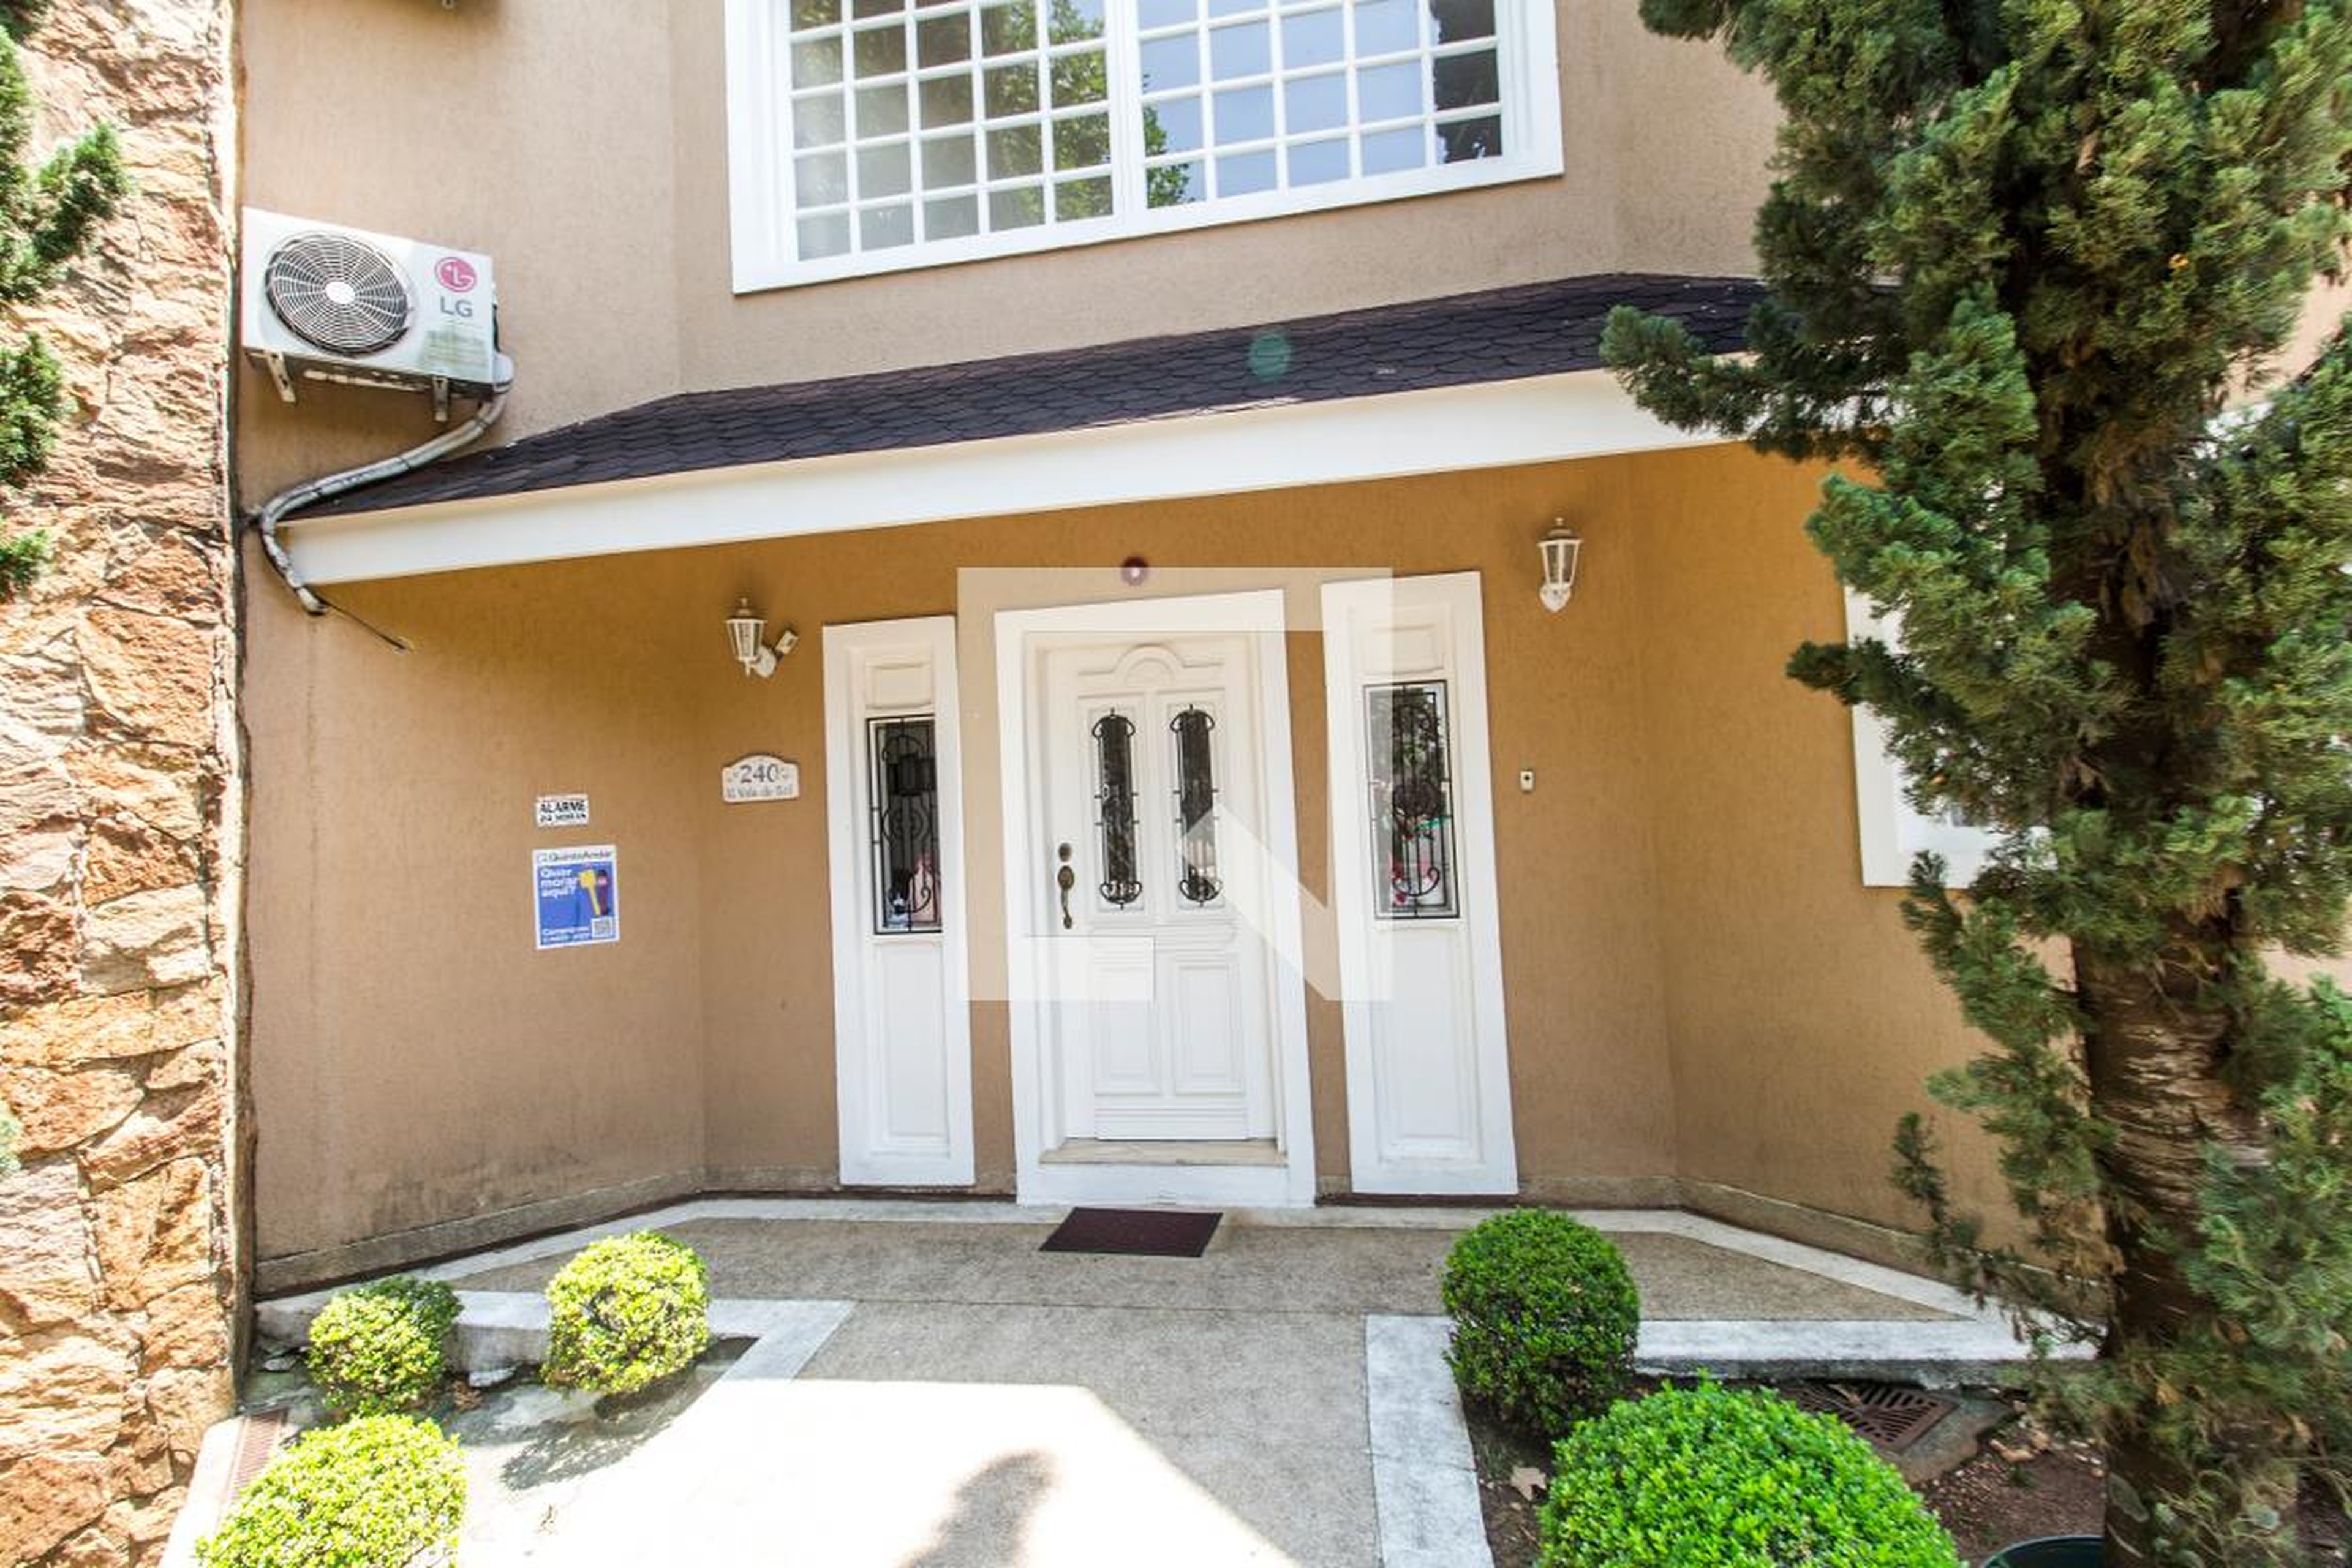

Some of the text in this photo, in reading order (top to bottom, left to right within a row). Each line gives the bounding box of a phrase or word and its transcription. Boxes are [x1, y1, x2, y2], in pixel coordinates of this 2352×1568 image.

[440, 296, 473, 318] LG
[740, 763, 779, 783] 240
[540, 800, 586, 813] ALARME
